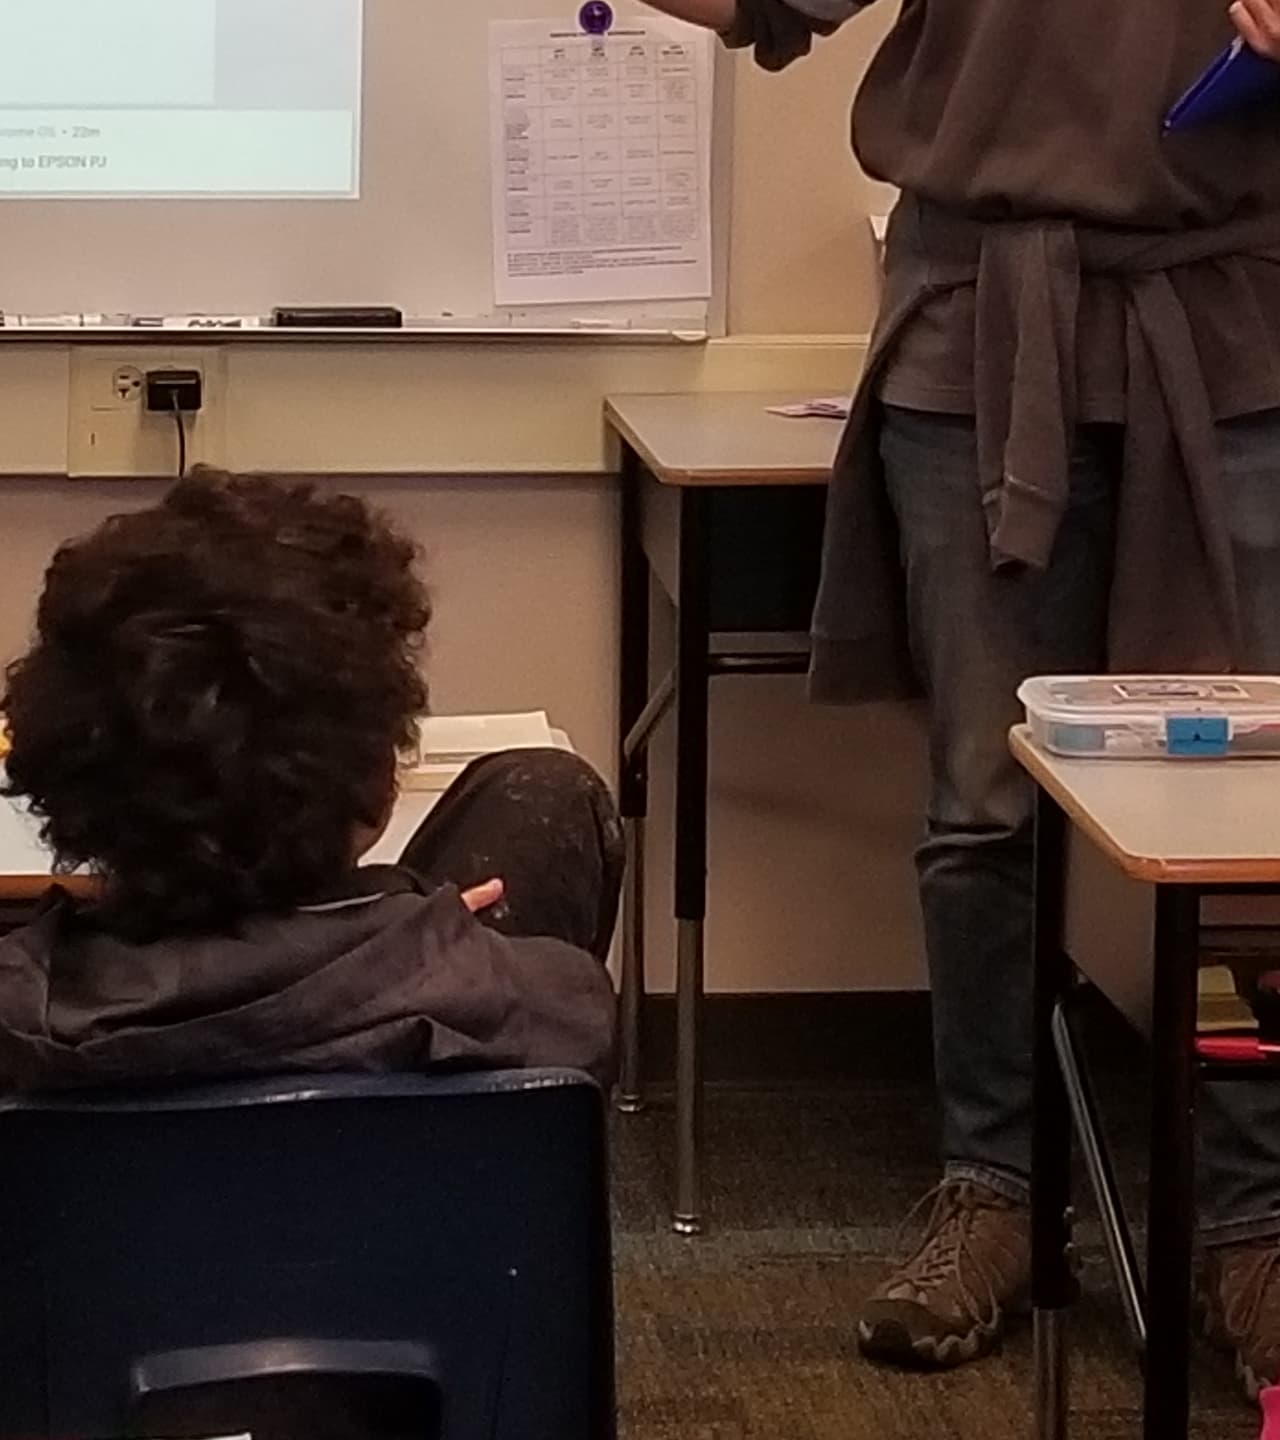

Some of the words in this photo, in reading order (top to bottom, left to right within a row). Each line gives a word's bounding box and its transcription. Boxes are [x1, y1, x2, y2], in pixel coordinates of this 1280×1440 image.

[22, 156, 35, 168] to
[38, 155, 86, 168] EPSON
[90, 155, 107, 168] PJ
